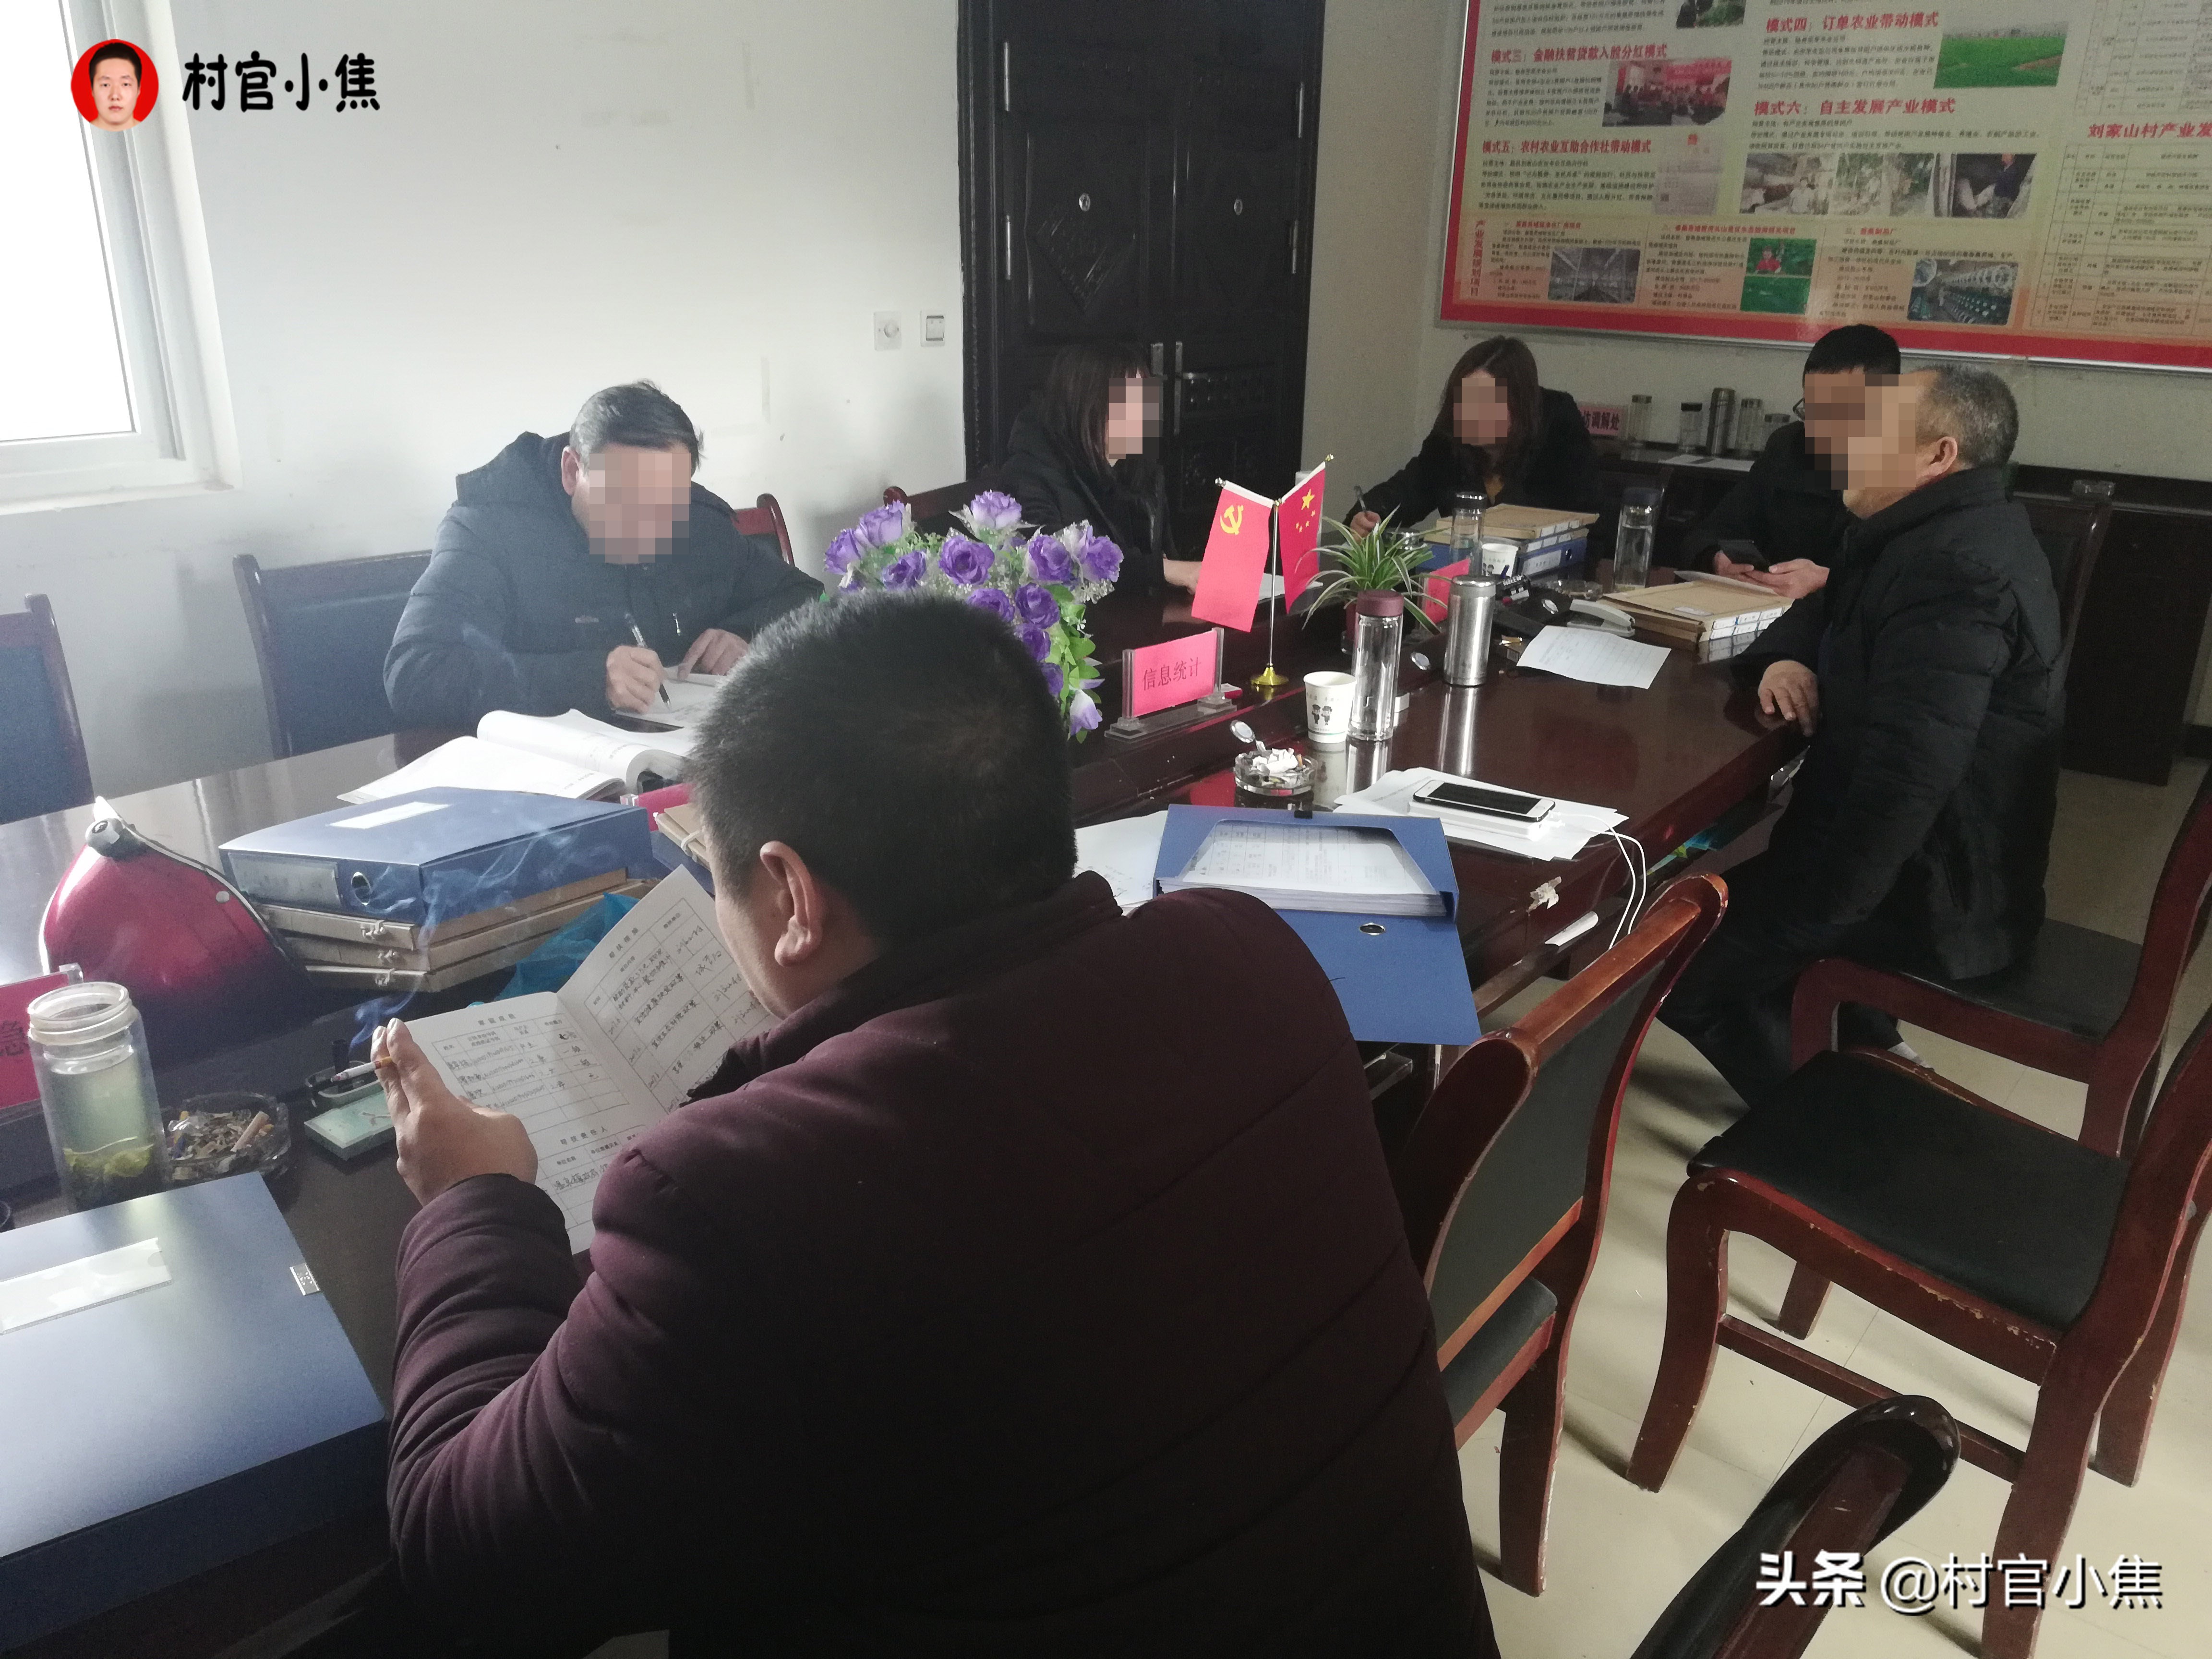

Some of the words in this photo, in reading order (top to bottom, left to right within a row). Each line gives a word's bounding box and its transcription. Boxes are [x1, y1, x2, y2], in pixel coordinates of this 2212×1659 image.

[1754, 97, 1956, 116] 模式六：自主发展产业模式
[1142, 657, 1202, 691] 信息统计
[560, 1126, 608, 1145] 帮扶责任人
